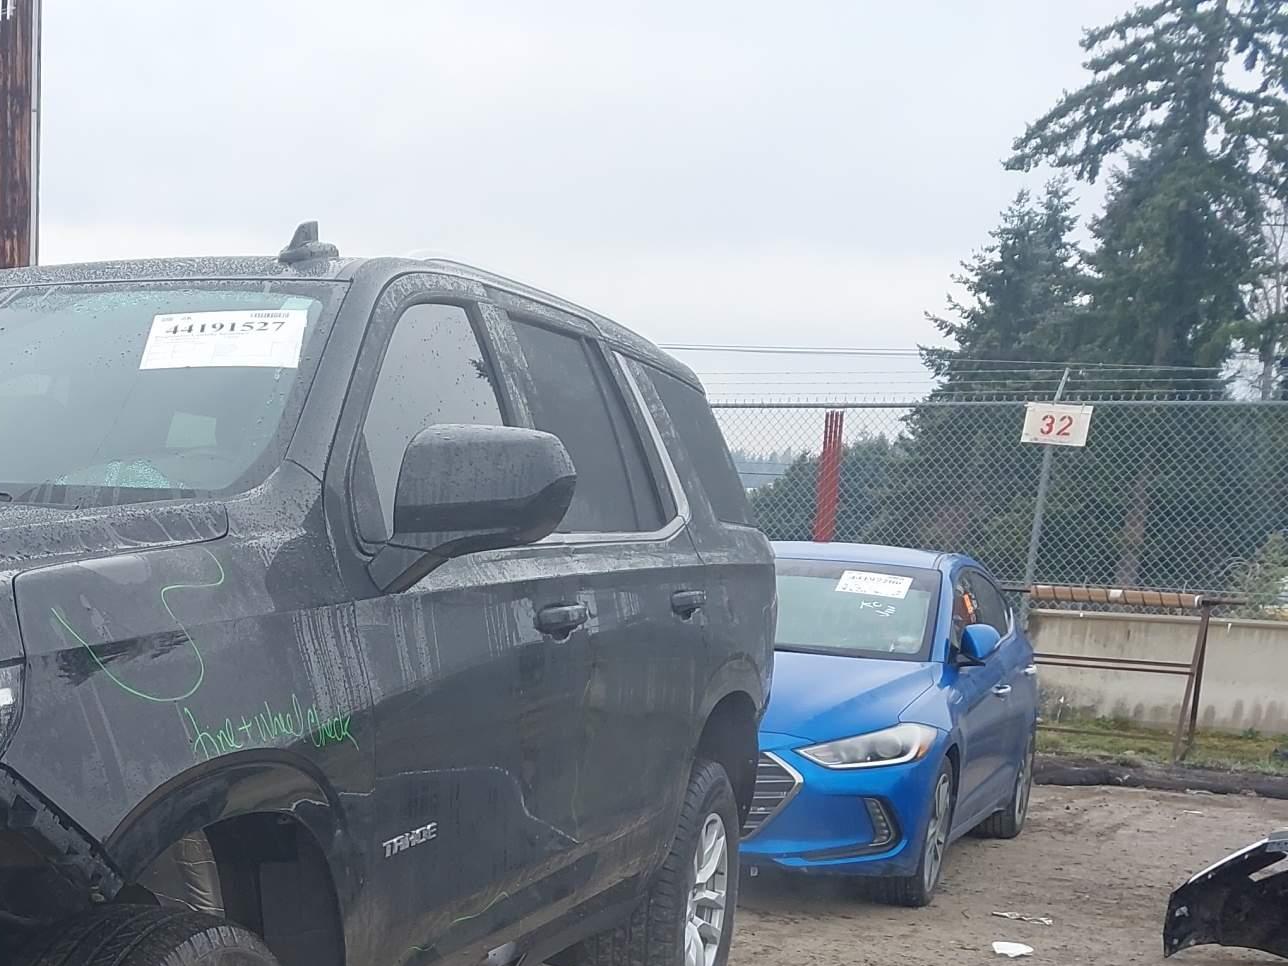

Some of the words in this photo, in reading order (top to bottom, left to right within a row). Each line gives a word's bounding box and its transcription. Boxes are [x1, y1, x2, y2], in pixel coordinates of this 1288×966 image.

[165, 320, 286, 335] 44191527
[1040, 414, 1074, 436] 32
[382, 821, 438, 858] TAHOE
